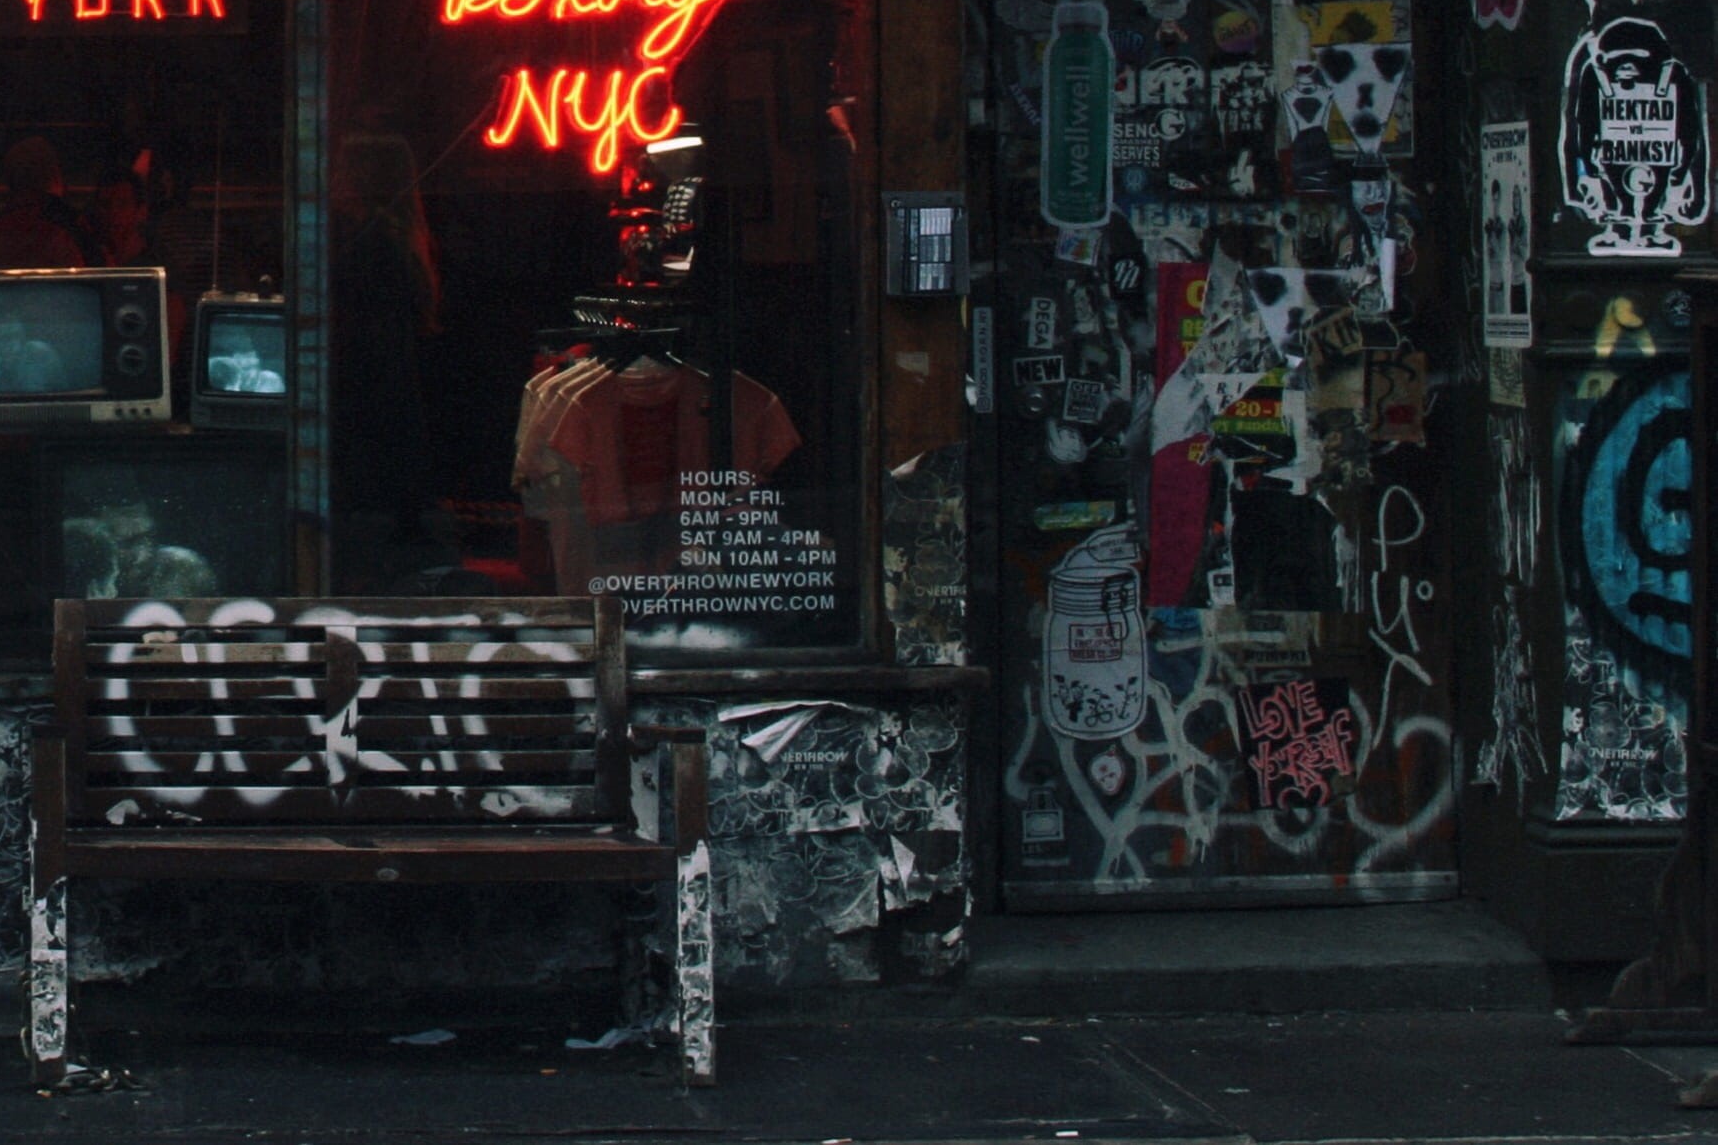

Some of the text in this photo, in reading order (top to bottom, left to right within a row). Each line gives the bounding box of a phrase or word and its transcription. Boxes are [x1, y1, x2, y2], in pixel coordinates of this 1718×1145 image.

[485, 66, 682, 175] NYC
[1601, 99, 1675, 121] HEKTAD
[1065, 65, 1091, 187] wellwell
[1602, 140, 1675, 162] BANKSY
[1035, 299, 1050, 346] DEGA
[1016, 358, 1063, 383] NEW
[680, 470, 757, 487] HOURS:
[680, 490, 731, 506] MON.
[749, 489, 786, 506] FRI.
[680, 510, 720, 526] 6AM
[738, 510, 779, 526] 9PM
[680, 530, 717, 546] SAT
[722, 530, 762, 546] 9AM
[780, 530, 821, 546] 4PM
[680, 550, 722, 566] SUN
[730, 550, 779, 566] 10AM
[797, 550, 837, 566] 4PM
[587, 571, 835, 594] @OVERTHROWNEWYORK
